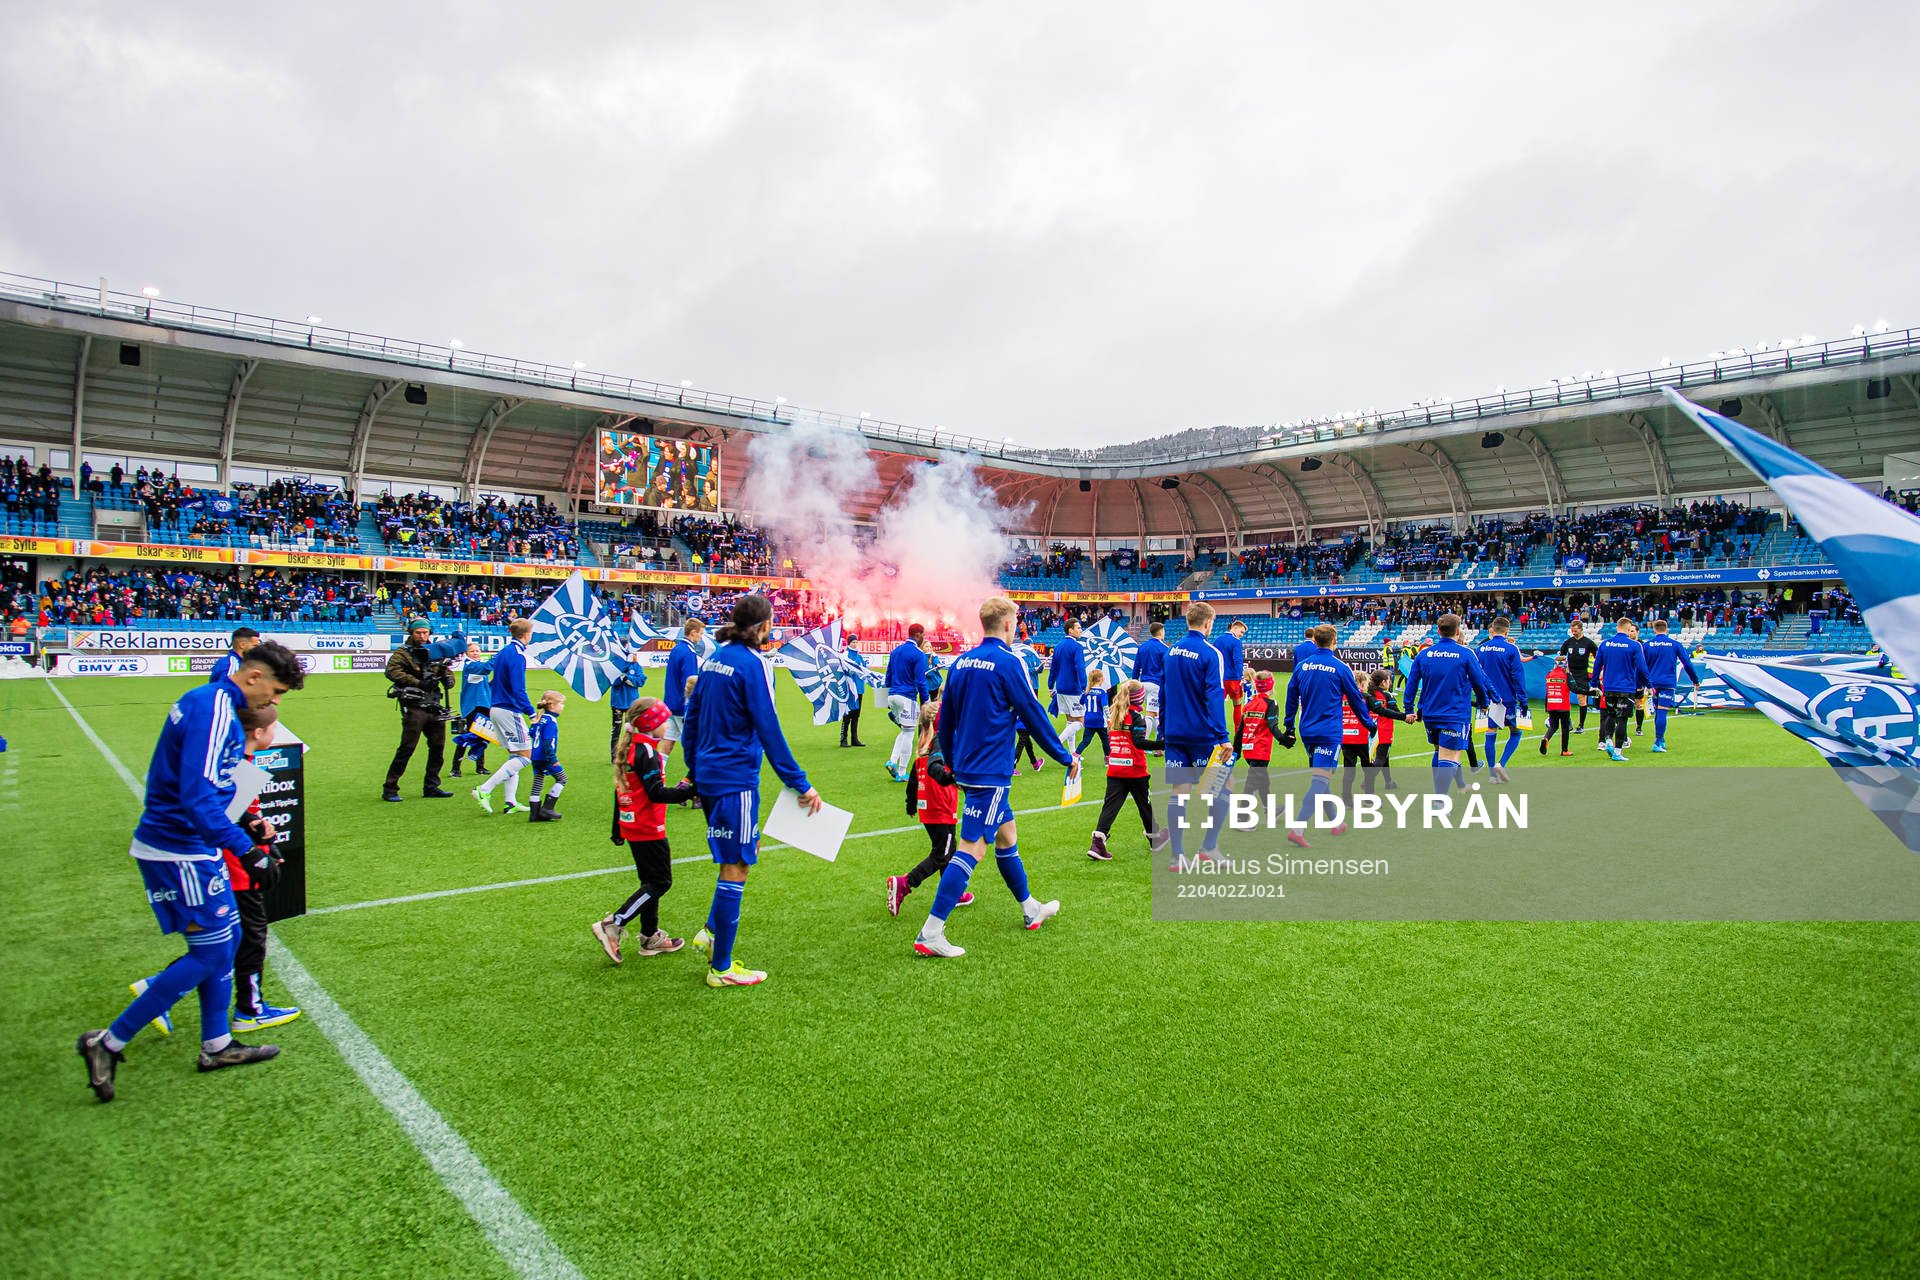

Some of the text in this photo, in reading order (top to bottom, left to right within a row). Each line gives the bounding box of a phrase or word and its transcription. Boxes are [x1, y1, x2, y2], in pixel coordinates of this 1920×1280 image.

[13, 538, 38, 552] Sylte
[136, 544, 203, 560] Oskar Sylte
[287, 553, 346, 566] Oskar Sylte
[1773, 569, 1819, 577] Sparebanken
[1565, 578, 1600, 586] Sparebanken
[99, 632, 234, 649] Reklameserv
[316, 640, 365, 648] BMV AS
[1175, 646, 1199, 660] fortum
[1338, 649, 1376, 660] Vikenco
[1433, 650, 1460, 659] fortum
[1484, 645, 1506, 653] fortum
[78, 663, 139, 672] BMV AS
[169, 658, 188, 670] HG
[334, 657, 350, 668] HG
[963, 657, 996, 671] fortum
[1308, 662, 1336, 674] fortum
[1086, 694, 1098, 712] 11
